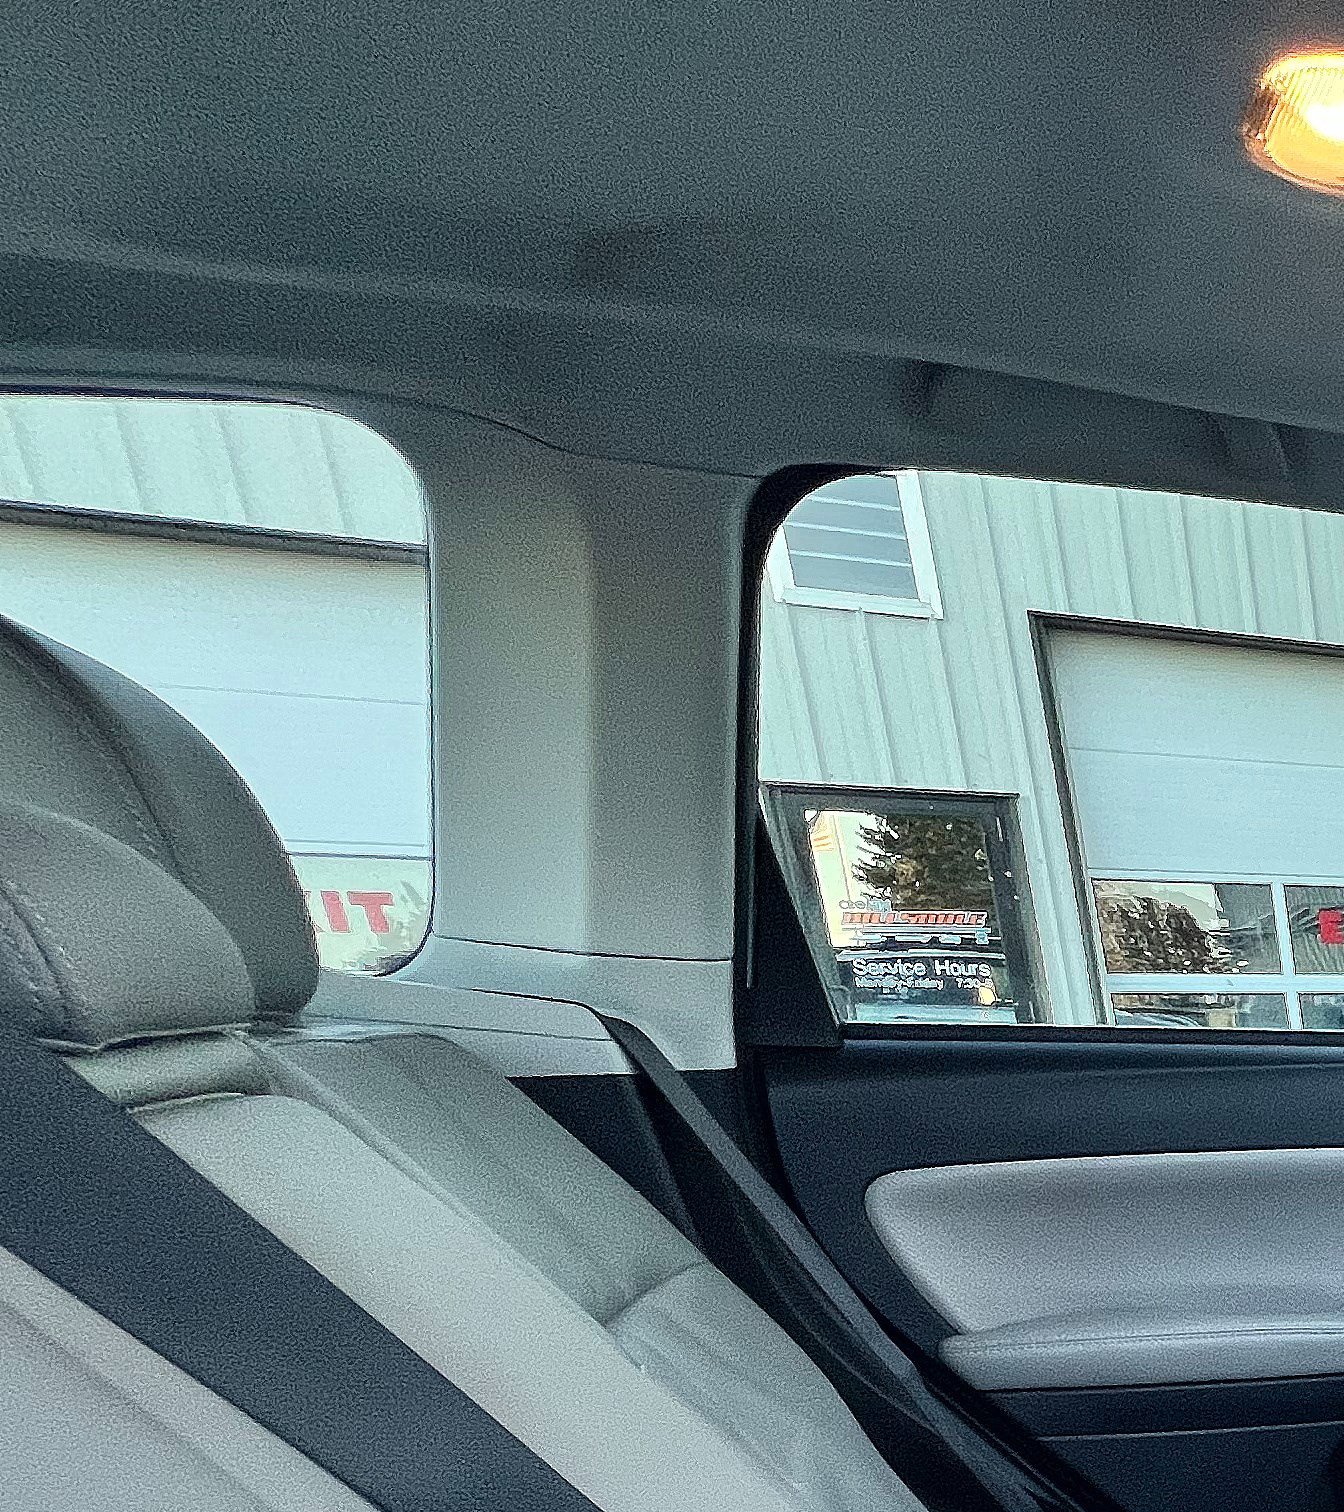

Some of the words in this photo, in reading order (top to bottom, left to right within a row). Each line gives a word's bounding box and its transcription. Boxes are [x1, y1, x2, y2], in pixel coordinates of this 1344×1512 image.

[304, 890, 395, 933] IT
[852, 958, 927, 976] Service
[934, 959, 992, 977] Hours
